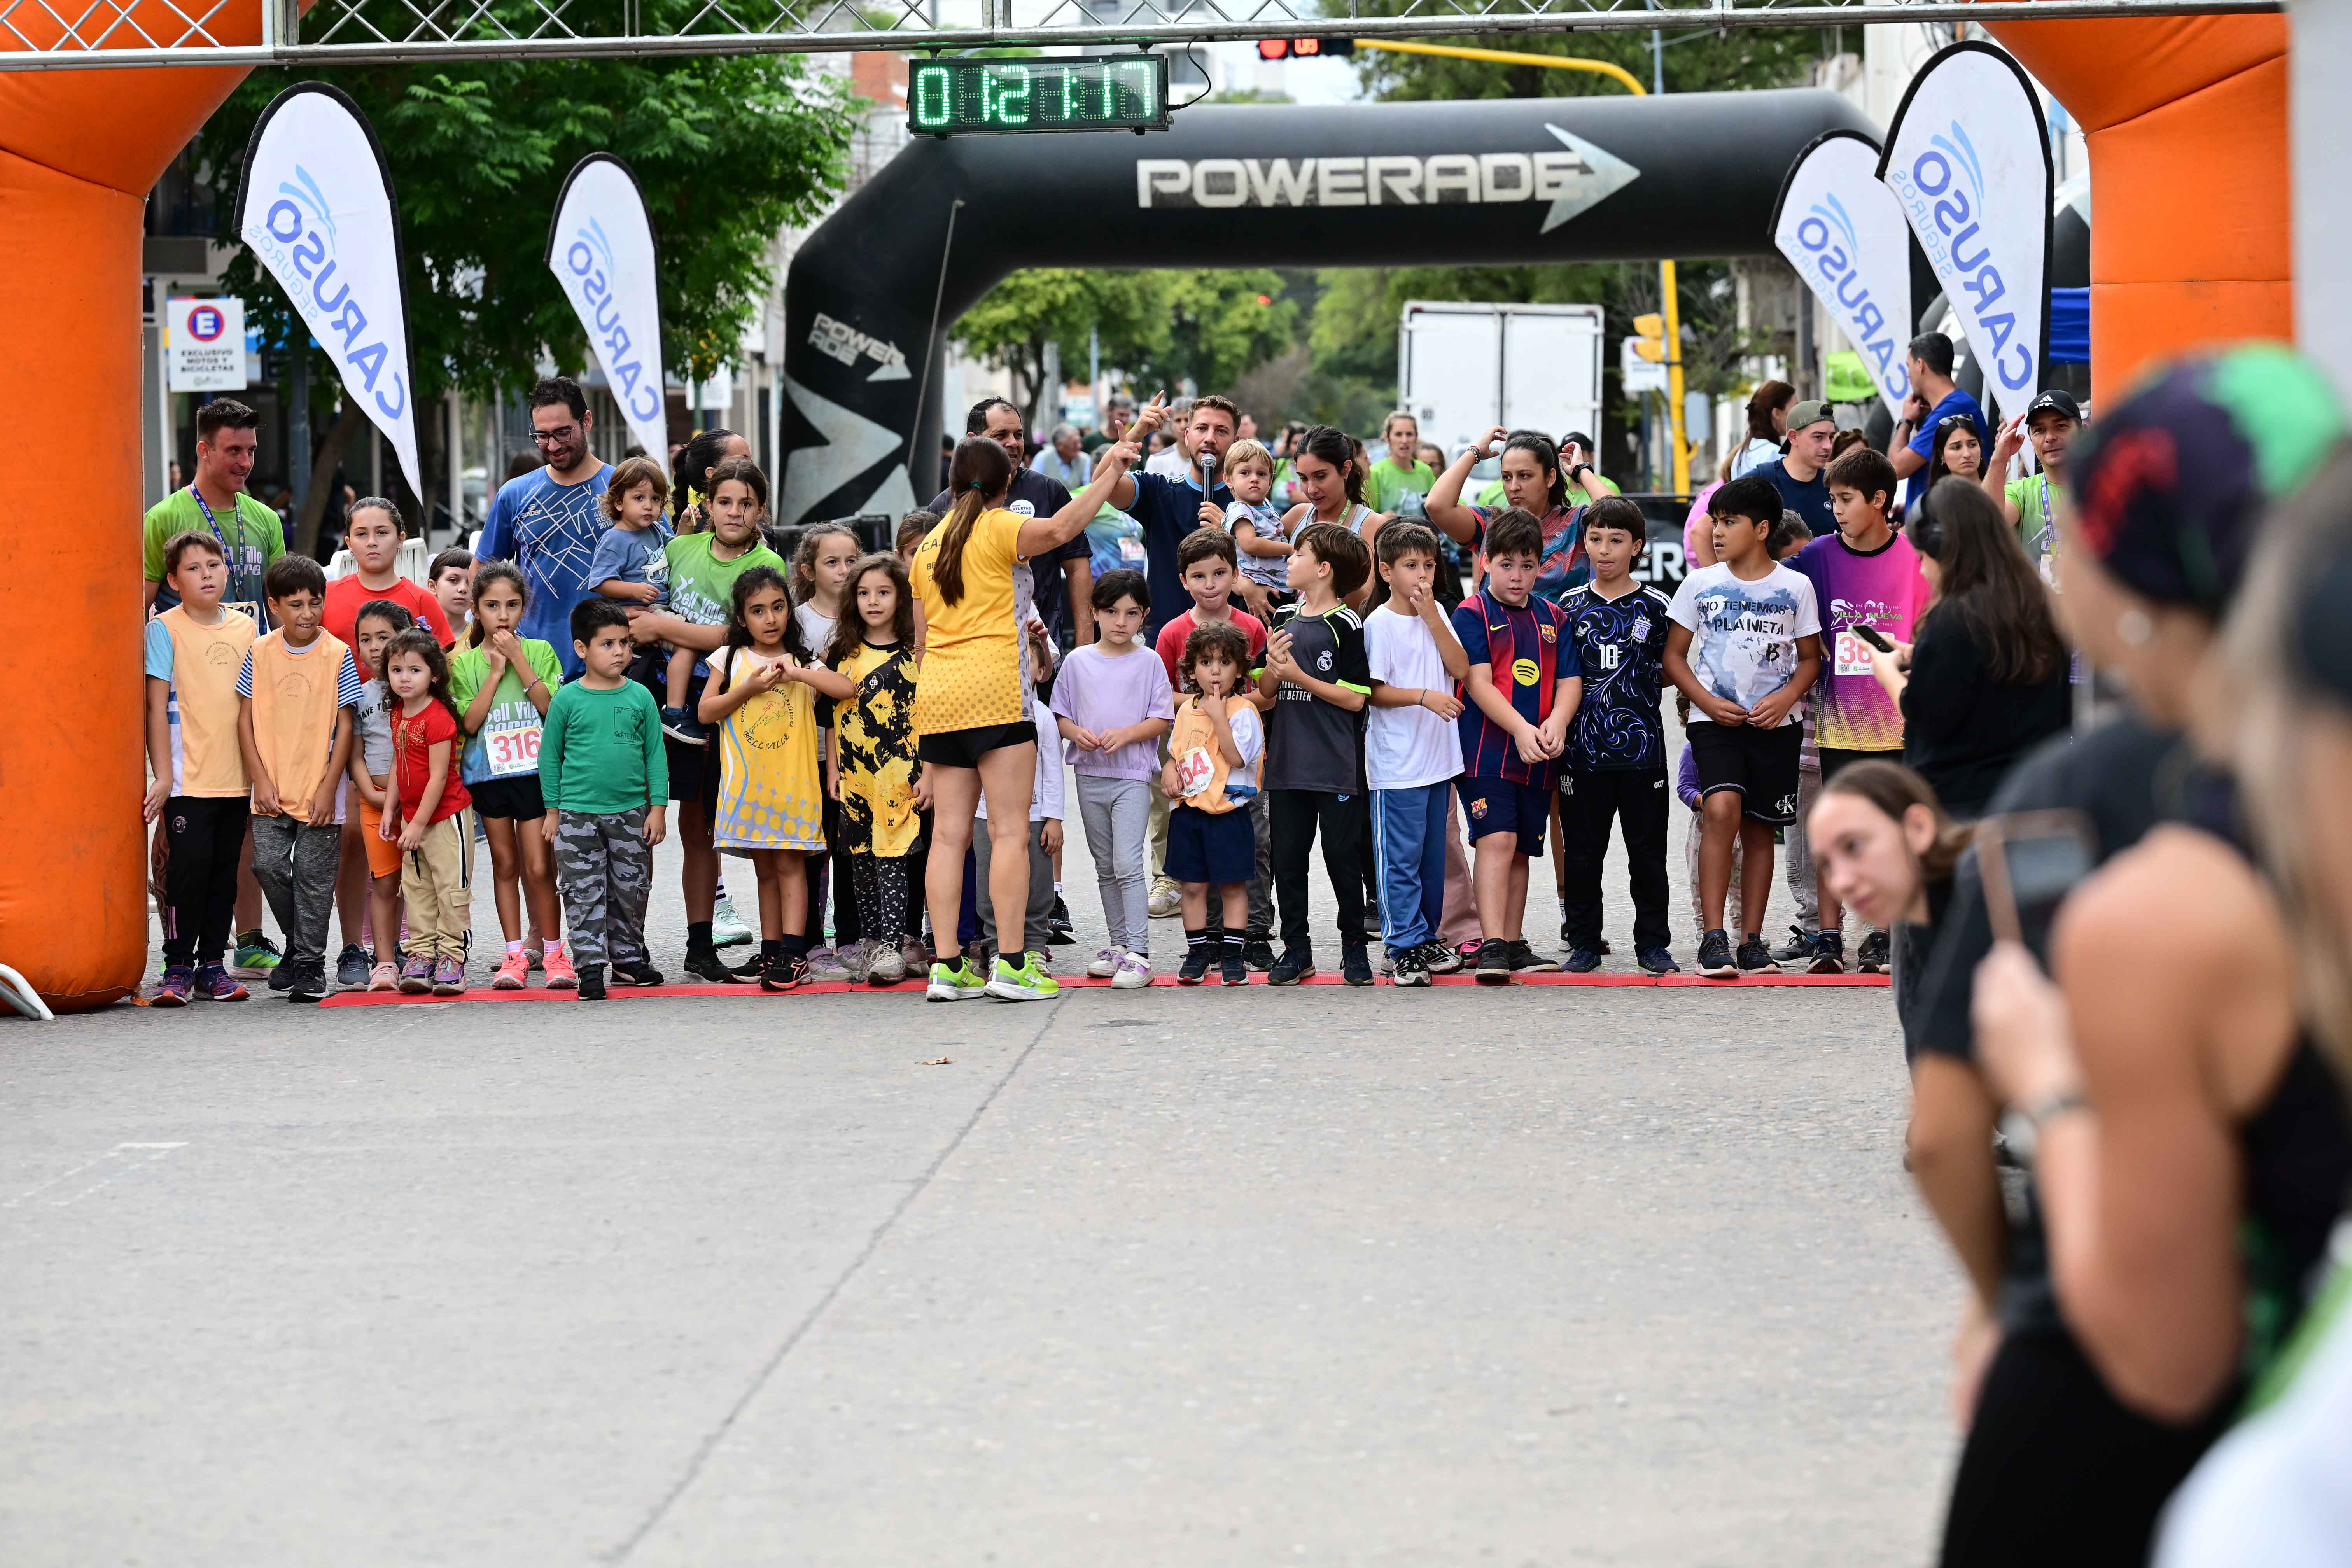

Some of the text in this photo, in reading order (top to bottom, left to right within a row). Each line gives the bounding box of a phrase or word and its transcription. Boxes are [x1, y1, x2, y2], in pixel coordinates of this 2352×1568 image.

[1136, 152, 1587, 208] POWERADE
[196, 312, 215, 335] E
[813, 312, 905, 365] POWER
[598, 521, 613, 529] 2018
[700, 597, 727, 621] Ville
[1702, 600, 1787, 615] NO TENEMOS
[1869, 612, 1904, 620] NUEVA
[1713, 617, 1784, 635] PLANETA
[1599, 644, 1618, 669] 10
[1287, 690, 1312, 702] BETTER
[494, 730, 541, 763] 316
[743, 731, 790, 750] BELL VILLE
[1176, 752, 1209, 786] 54
